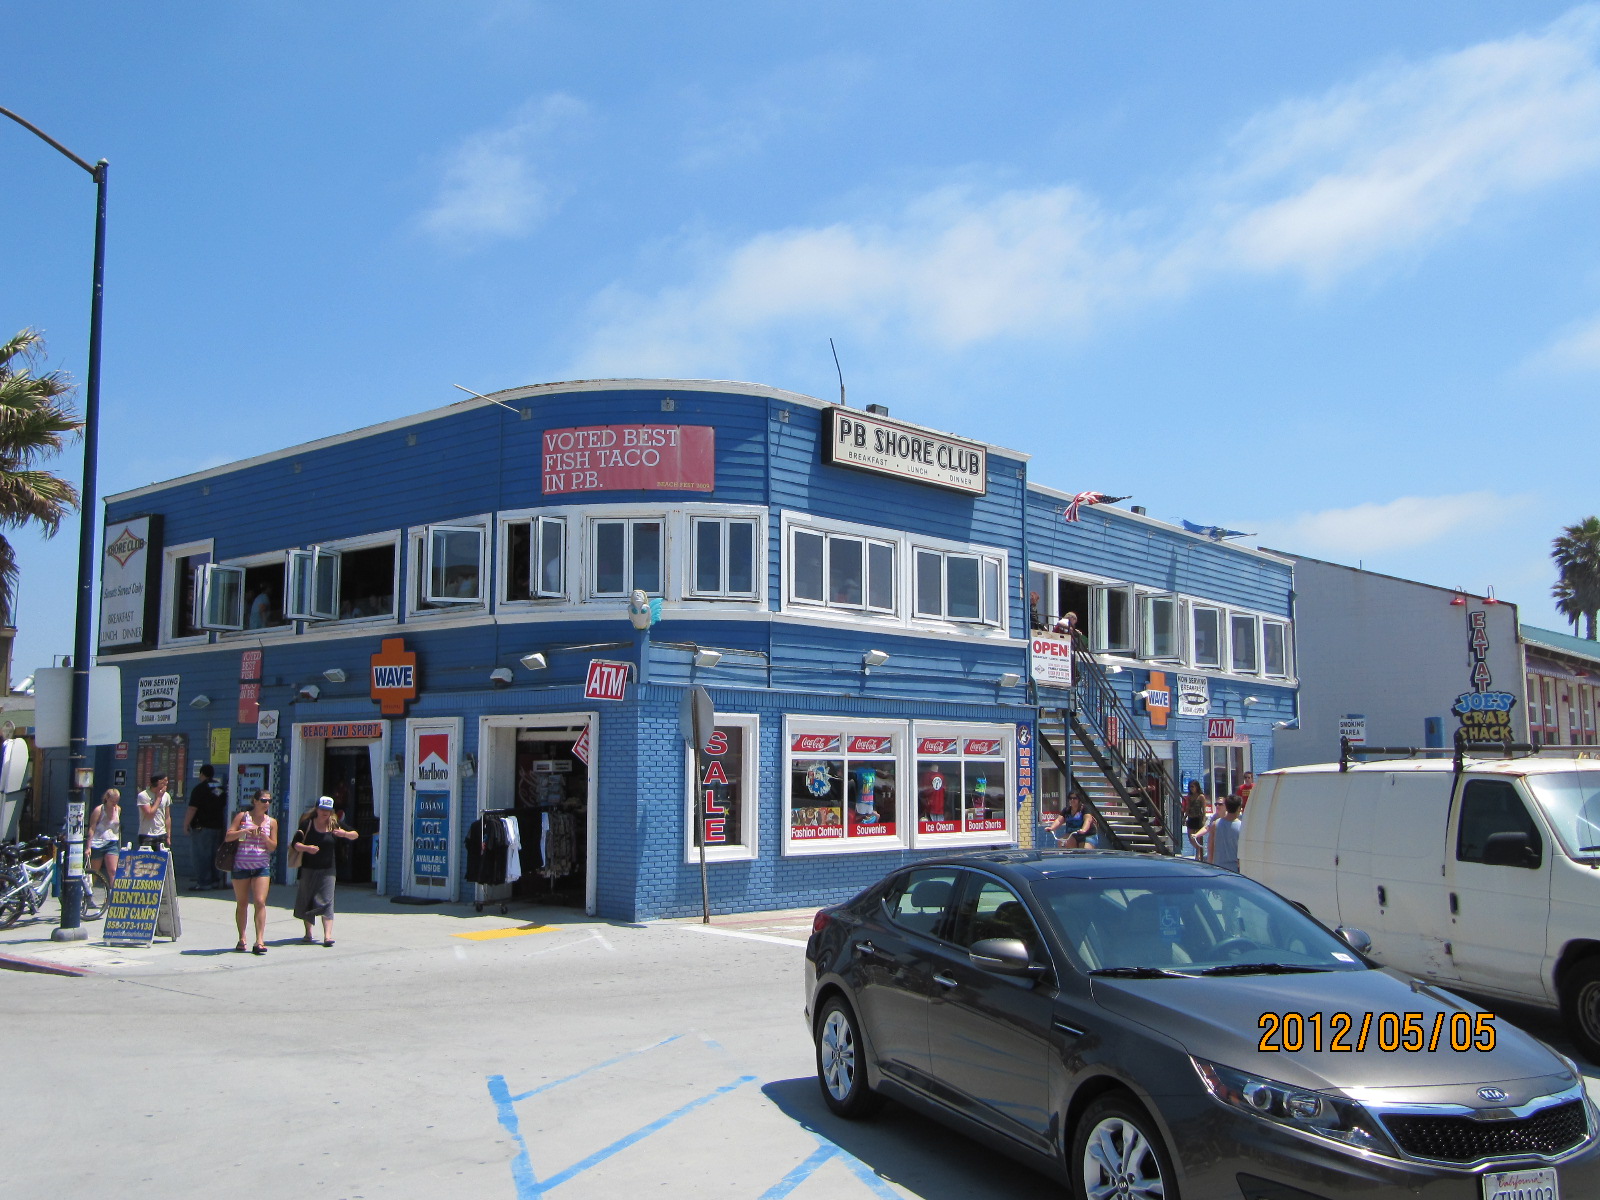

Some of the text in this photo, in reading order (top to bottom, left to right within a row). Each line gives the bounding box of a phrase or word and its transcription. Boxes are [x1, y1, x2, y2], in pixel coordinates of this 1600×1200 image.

[545, 428, 679, 451] VOTED BEST
[874, 428, 934, 467] SHORE
[937, 443, 980, 477] CLUB
[545, 449, 660, 472] FISH TACO
[848, 451, 972, 485] BREAKFAST LUNCH DINNER
[545, 471, 603, 492] IN P.B.
[127, 538, 145, 553] CLUB
[131, 582, 143, 597] Daily
[108, 611, 134, 624] BREAKFAST
[100, 627, 142, 642] LUNCH DINNER
[1472, 611, 1489, 659] EAT
[1033, 640, 1068, 657] OPEN
[243, 651, 262, 661] VOTED
[242, 661, 256, 671] BEST
[241, 670, 254, 679] FISH
[374, 666, 413, 687] WAVE
[588, 666, 625, 696] ATM
[1178, 675, 1188, 683] NOW
[1474, 661, 1491, 692] AT
[139, 677, 178, 688] NOW SERVING
[142, 687, 174, 698] BREAKFAST
[1149, 690, 1168, 706] WAVE
[1455, 692, 1514, 713] JOE'S
[1461, 711, 1510, 725] CRAB
[303, 724, 379, 737] BEACH AND SPORT
[1209, 720, 1232, 737] ATM
[1459, 726, 1513, 741] SHACK
[418, 762, 449, 780] Marlboro
[1019, 747, 1031, 796] HENNA
[703, 730, 729, 842] SALE
[420, 801, 444, 811] DASANI
[421, 821, 442, 835] ICE
[791, 826, 843, 838] Fashion Clothing
[856, 824, 887, 835] Souvenirs
[925, 822, 955, 832] Ice Cream
[968, 820, 1002, 830] Board Shorts
[415, 837, 447, 851] COLD
[415, 854, 446, 864] AVAILABLE
[421, 863, 441, 873] INSIDE
[114, 879, 162, 891] SURF LESSONS
[112, 891, 158, 905] RENTALS
[108, 906, 157, 920] SURF CAMPS
[106, 920, 153, 930] 858-373-1138
[1480, 1089, 1504, 1099] KIA
[1498, 1174, 1542, 1189] California
